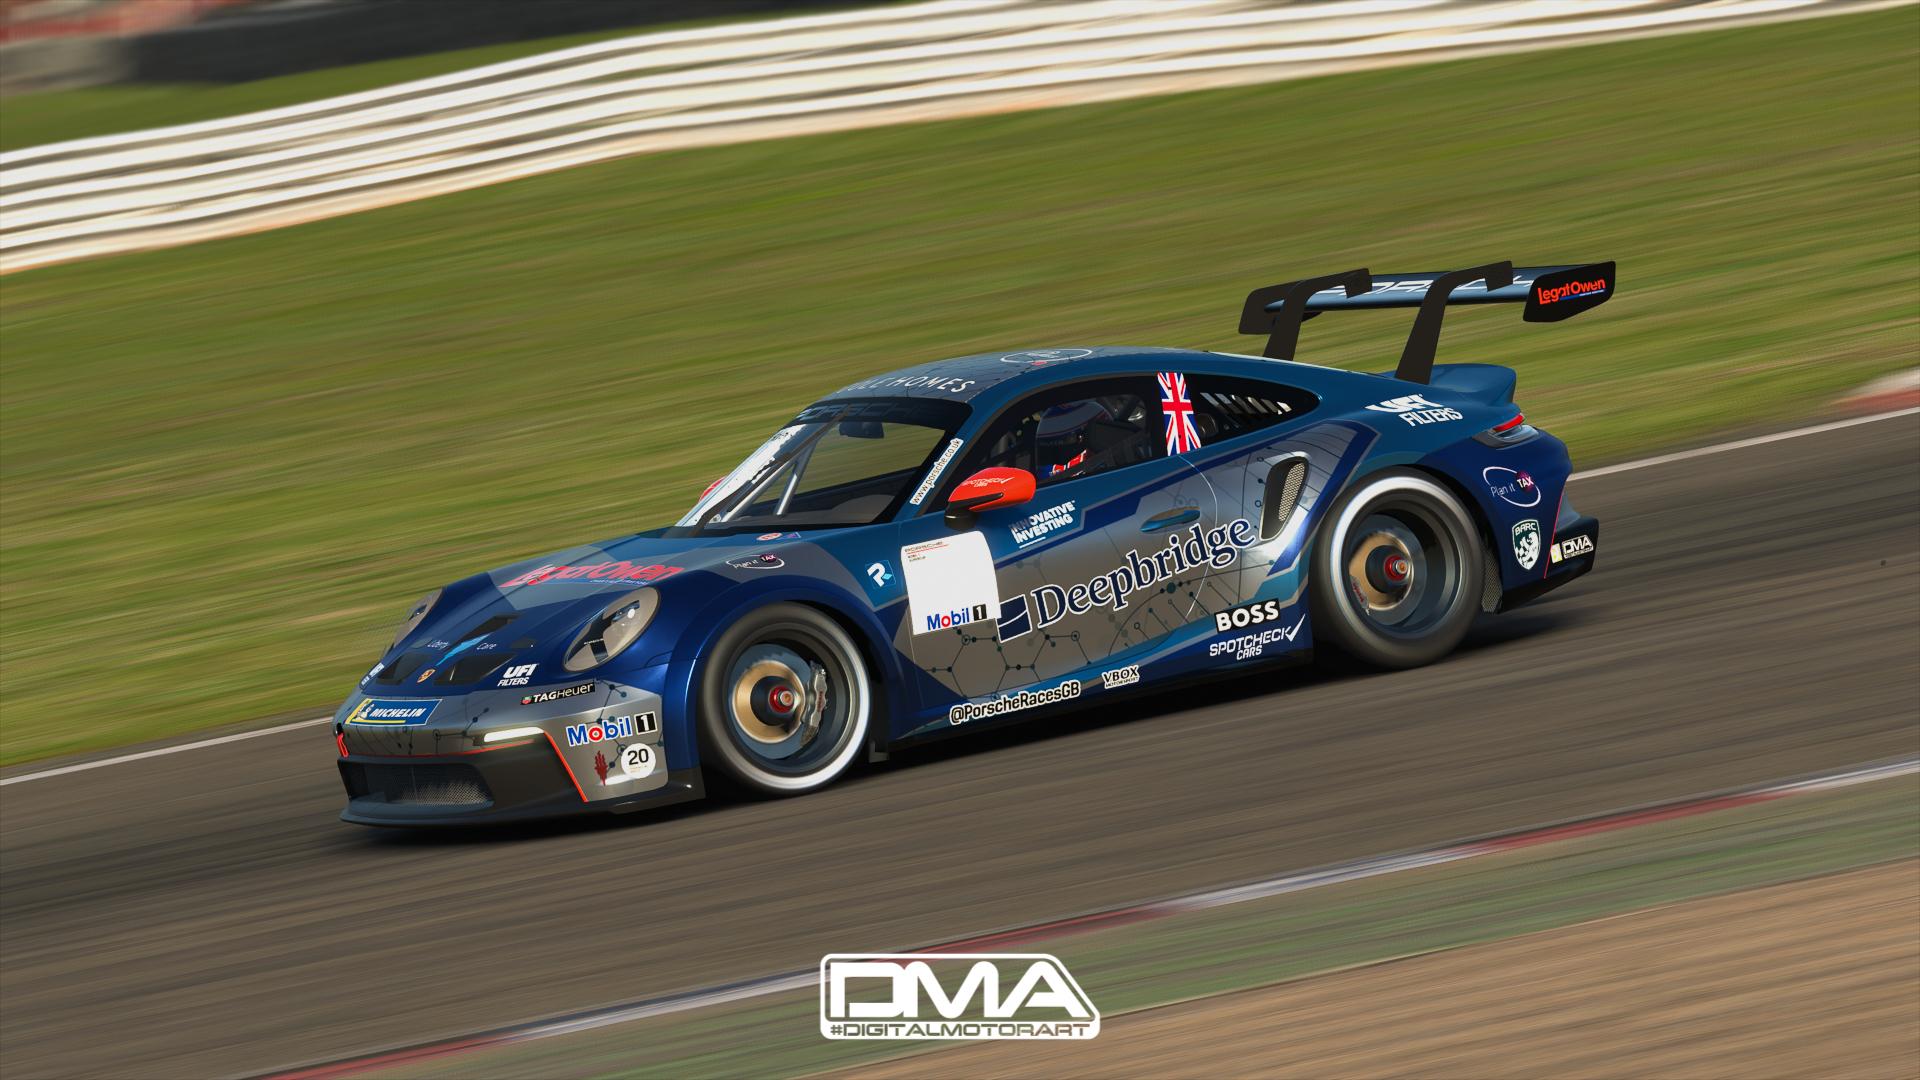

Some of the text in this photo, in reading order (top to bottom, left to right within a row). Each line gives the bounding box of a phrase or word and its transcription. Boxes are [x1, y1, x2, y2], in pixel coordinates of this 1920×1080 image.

[1538, 279, 1606, 305] LegatOwen
[886, 376, 976, 393] HOMES
[1398, 408, 1464, 426] FILTERS
[911, 439, 962, 505] www.porsche.co.uk
[1517, 477, 1534, 488] TAX
[1009, 501, 1075, 531] INNOVATIVE
[1010, 515, 1073, 543] INVESTING
[1514, 523, 1537, 536] BARC
[1562, 537, 1592, 554] DMA
[1033, 519, 1253, 627] Deepbridge
[927, 605, 986, 631] Mobil 1
[1216, 601, 1279, 632] BOSS
[1210, 618, 1301, 657] SPOTCHECK
[1236, 645, 1263, 660] CARS
[503, 663, 538, 679] UFI
[1103, 666, 1138, 683] VBOX
[497, 677, 530, 687] FILTERS
[950, 680, 1082, 725] @PorscheRacesGB
[369, 707, 428, 718] MICHELIN
[567, 713, 653, 746] Mobil 1
[627, 749, 649, 766] 20
